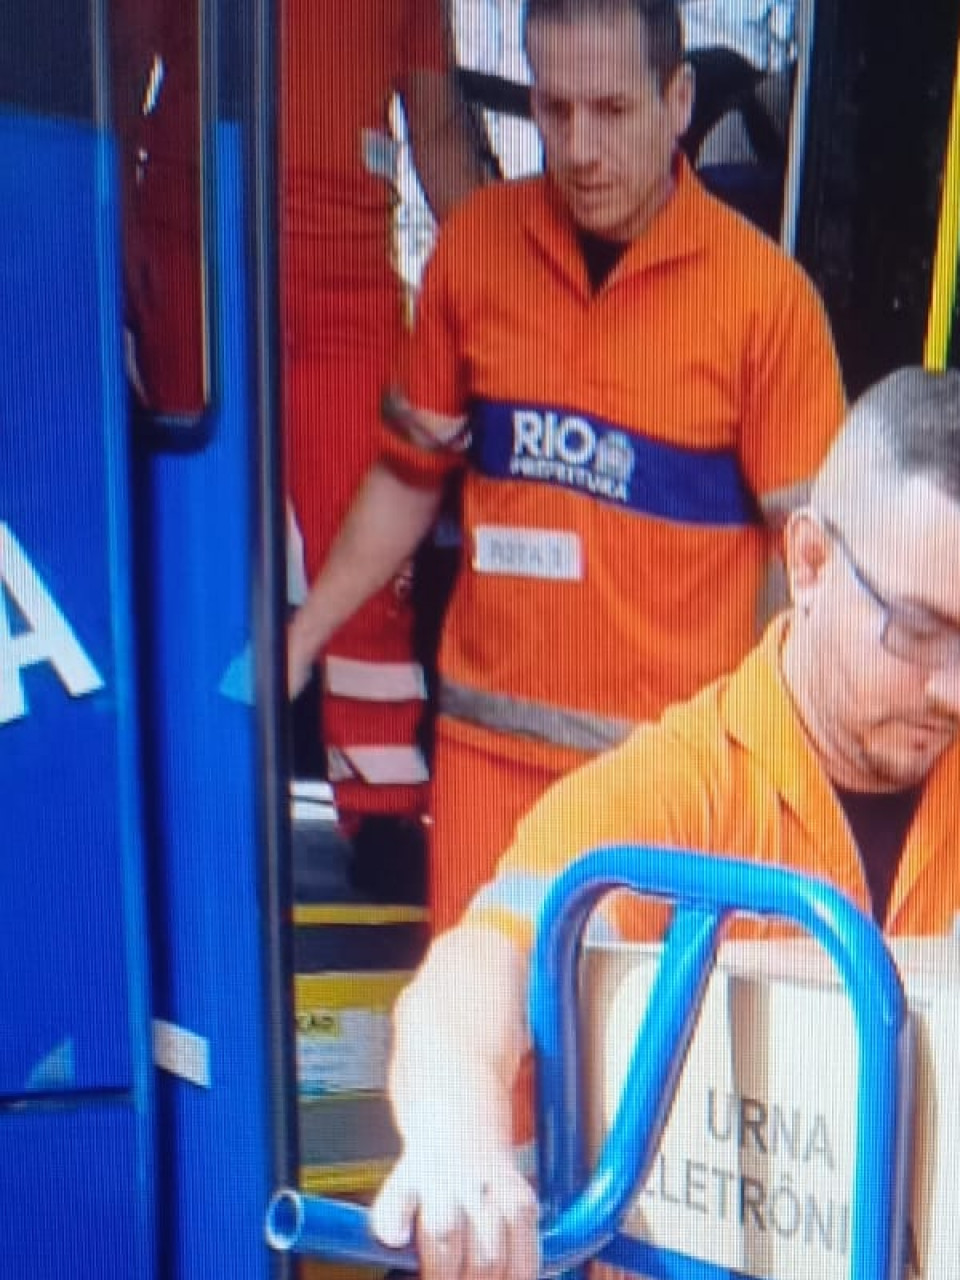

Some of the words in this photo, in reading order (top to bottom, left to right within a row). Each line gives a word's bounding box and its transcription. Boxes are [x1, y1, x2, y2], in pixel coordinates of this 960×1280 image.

[513, 410, 596, 465] RIO
[706, 1086, 835, 1171] URNA
[650, 1150, 851, 1258] LETRÔNI
